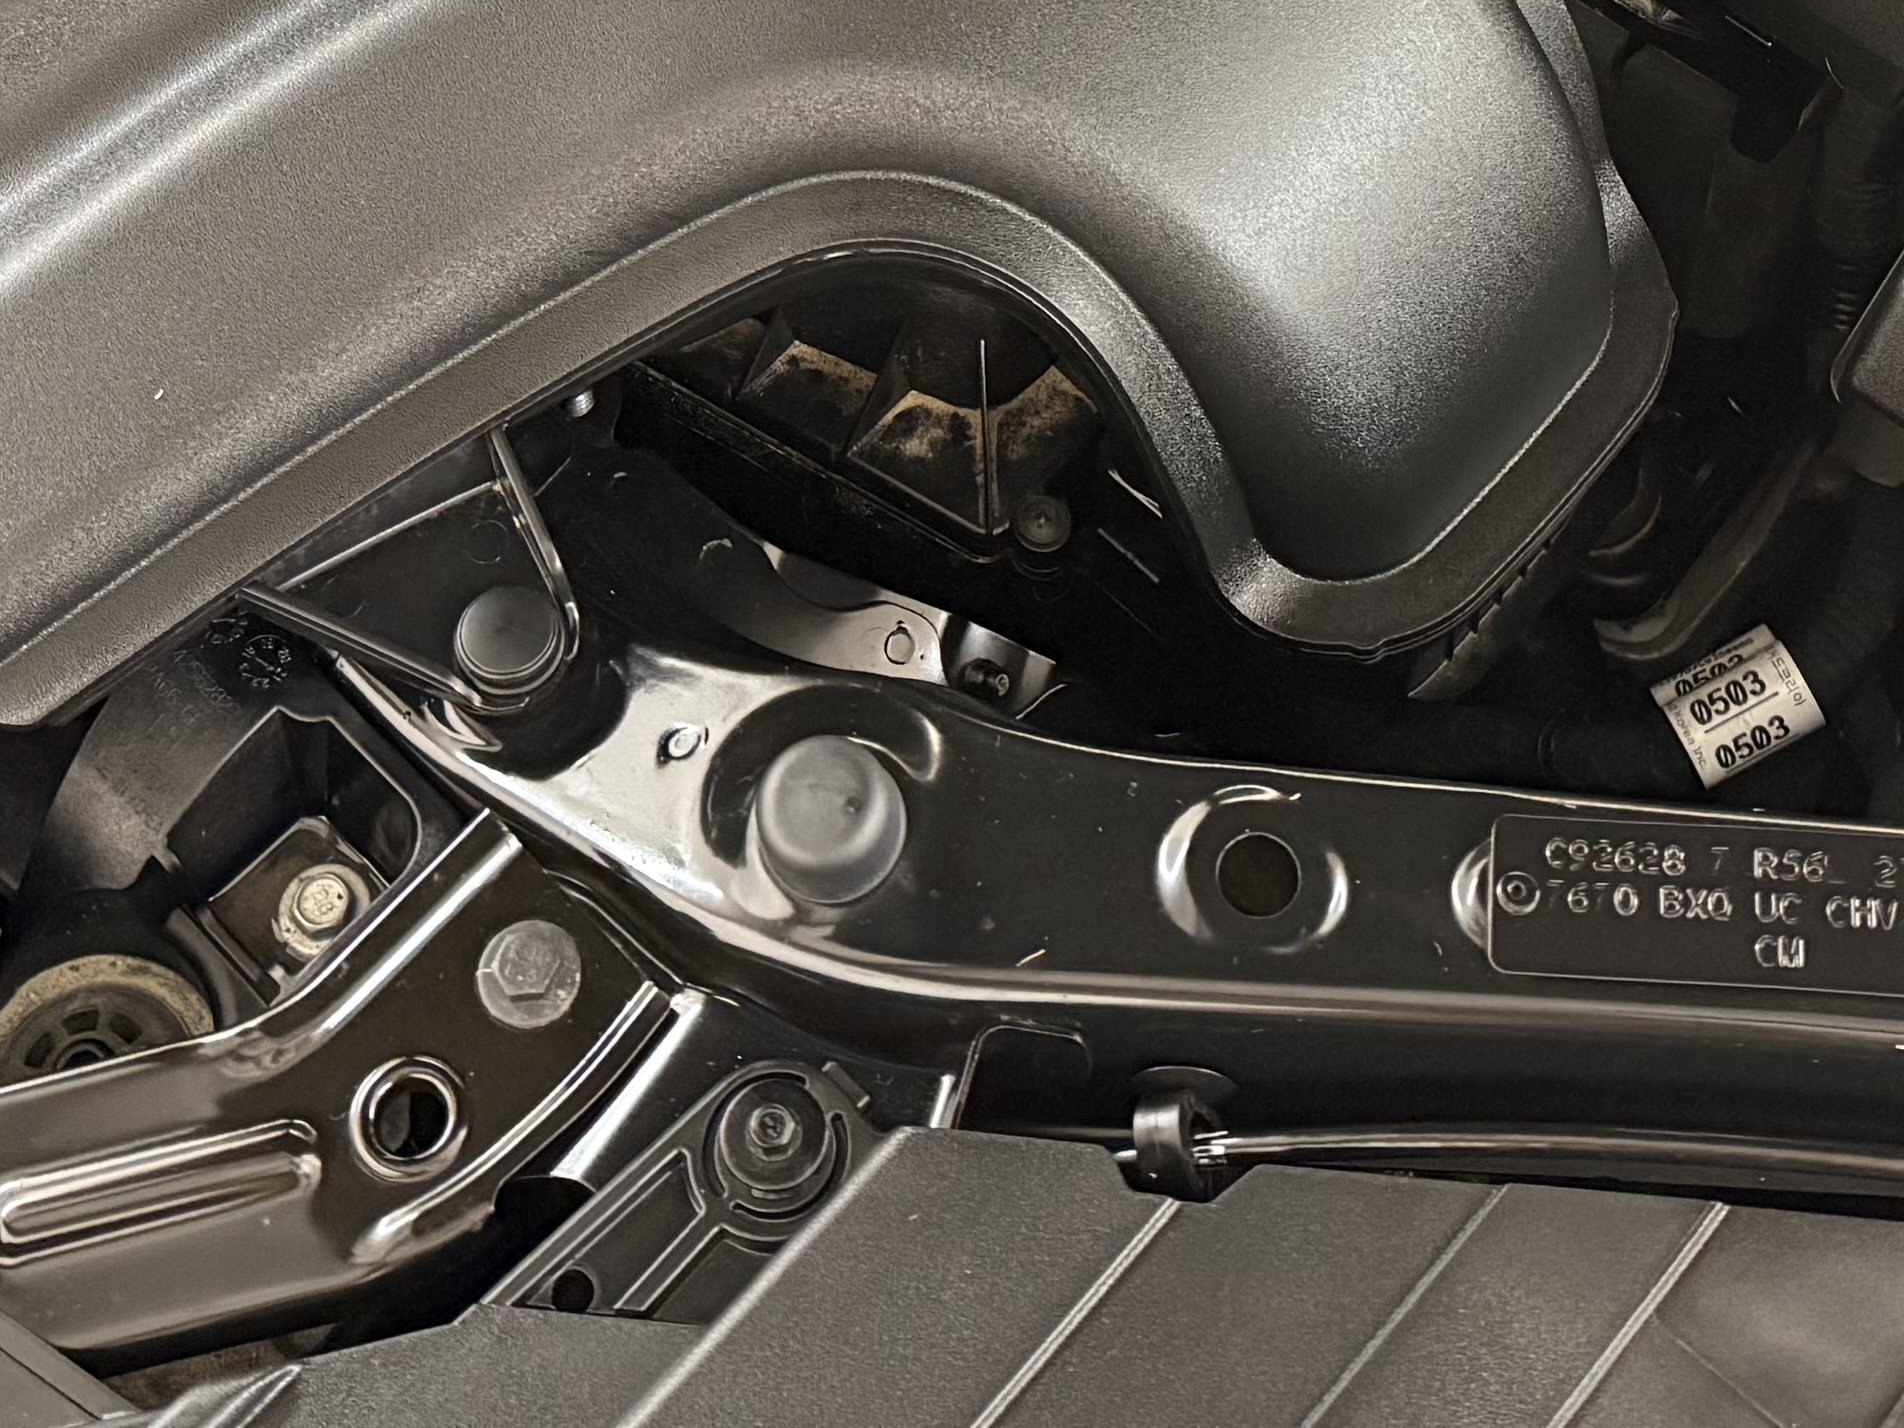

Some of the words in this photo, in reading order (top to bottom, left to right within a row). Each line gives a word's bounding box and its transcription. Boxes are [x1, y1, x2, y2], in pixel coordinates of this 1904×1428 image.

[1689, 670, 1767, 727] 0503
[1715, 714, 1790, 769] 0503
[1545, 836, 1687, 877] C92628
[1754, 891, 1803, 925] UC
[1825, 895, 1899, 931] CHV
